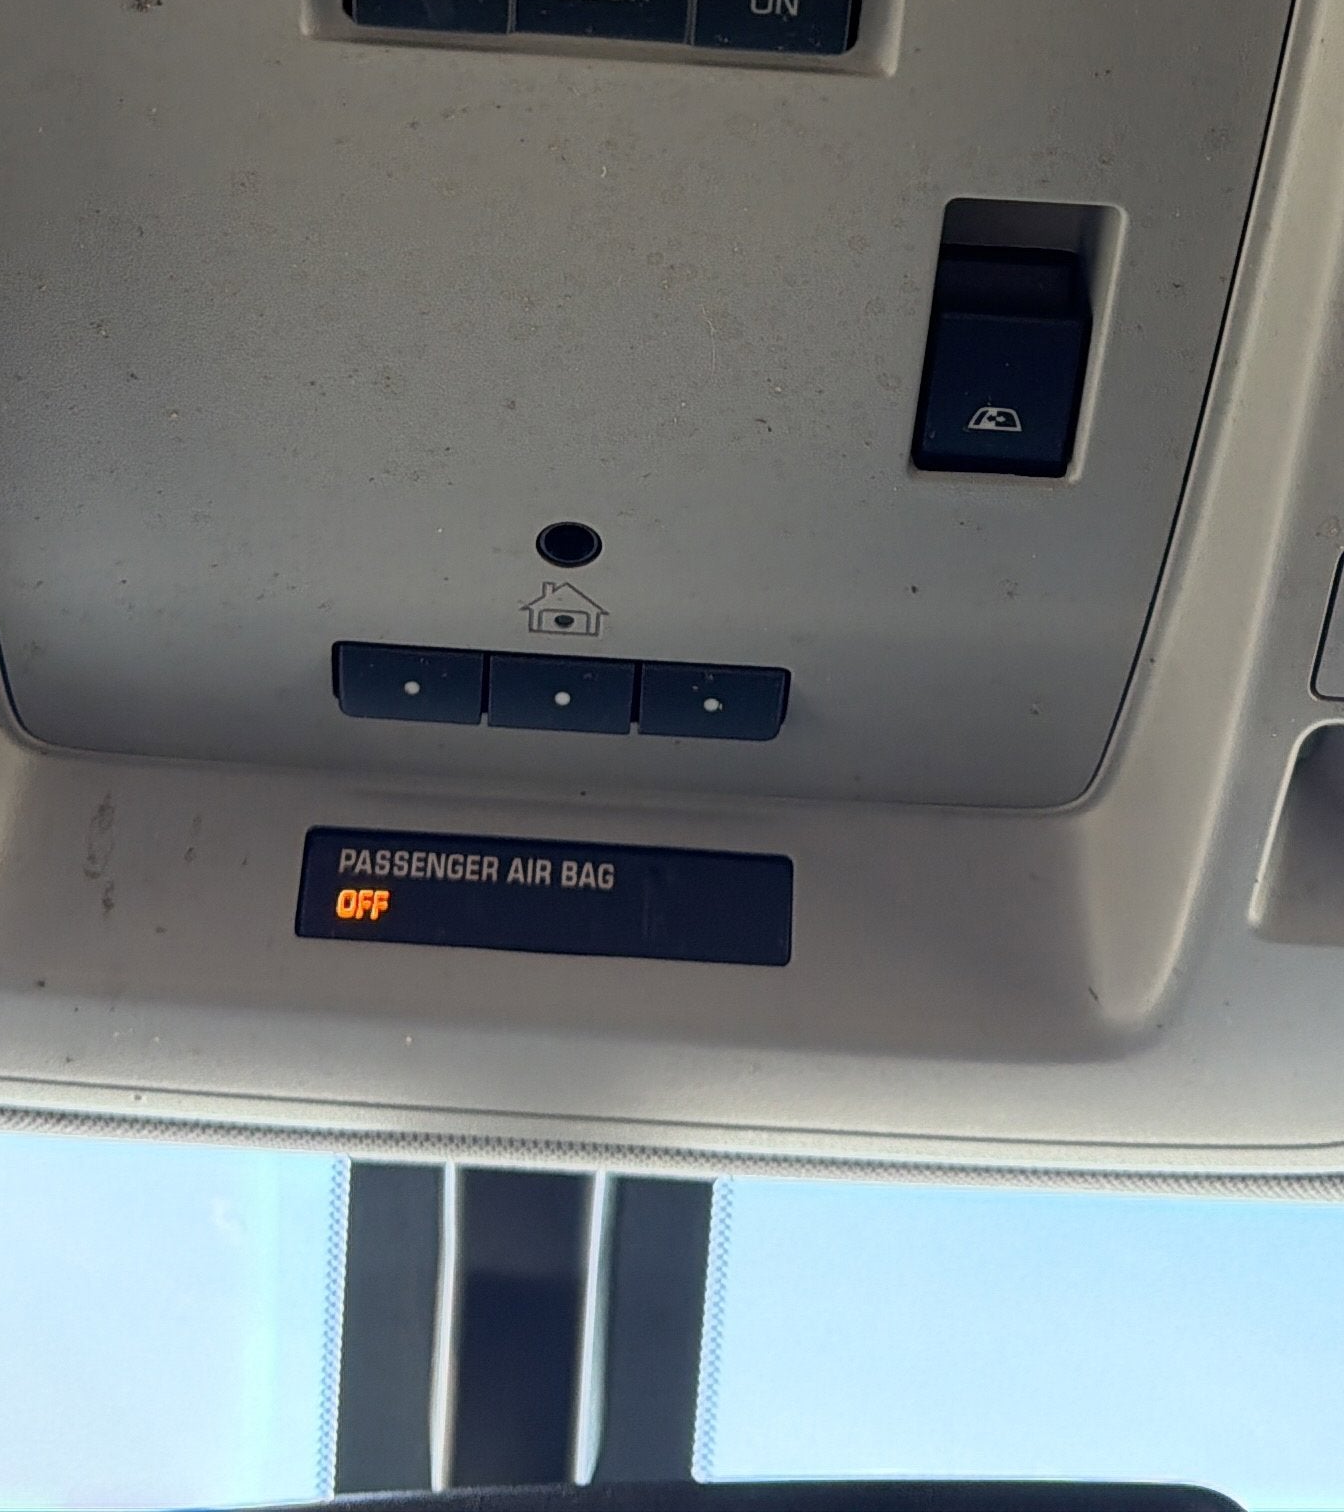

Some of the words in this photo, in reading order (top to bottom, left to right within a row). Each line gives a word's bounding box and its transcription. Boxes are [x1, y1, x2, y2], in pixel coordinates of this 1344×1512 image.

[338, 849, 499, 882] PASSENGER
[506, 857, 552, 886] AIR
[560, 860, 616, 890] BAG
[335, 890, 390, 920] OFF
